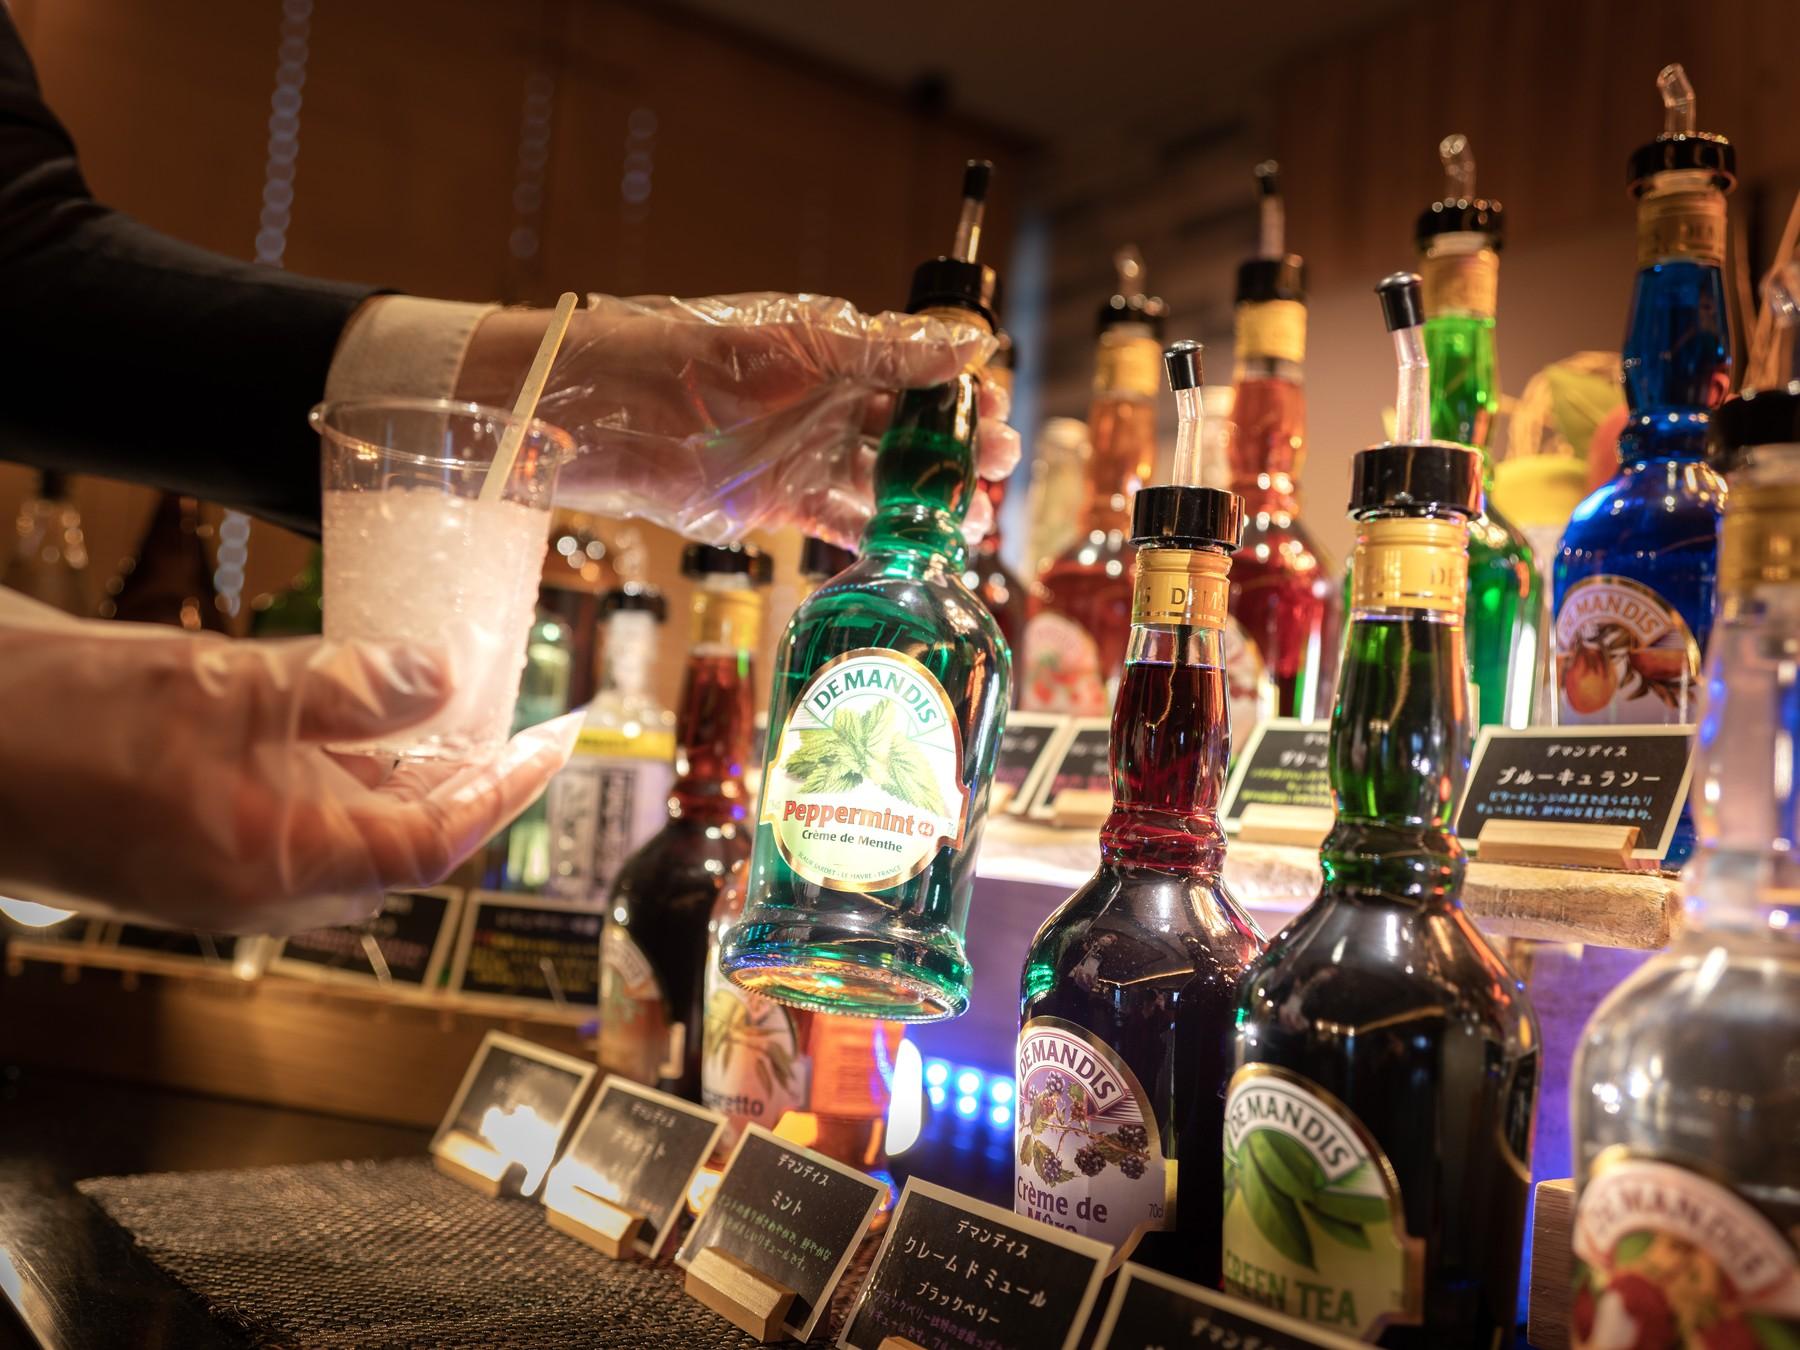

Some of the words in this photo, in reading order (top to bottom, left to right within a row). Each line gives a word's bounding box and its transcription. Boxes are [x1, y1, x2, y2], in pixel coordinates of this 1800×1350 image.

[1497, 766, 1661, 788] ブルーキュラソー
[783, 800, 915, 837] Peppermint
[802, 829, 837, 842] Crème
[840, 833, 855, 843] de
[858, 836, 903, 853] Menthe
[777, 1153, 830, 1188] デマンディス
[771, 1190, 802, 1217] ミント
[1018, 1176, 1068, 1216] Crème
[1076, 1197, 1108, 1223] de
[956, 1220, 1030, 1259] デマンディス
[916, 1281, 1000, 1324] ブラックベリー
[1295, 1279, 1359, 1329] TEA
